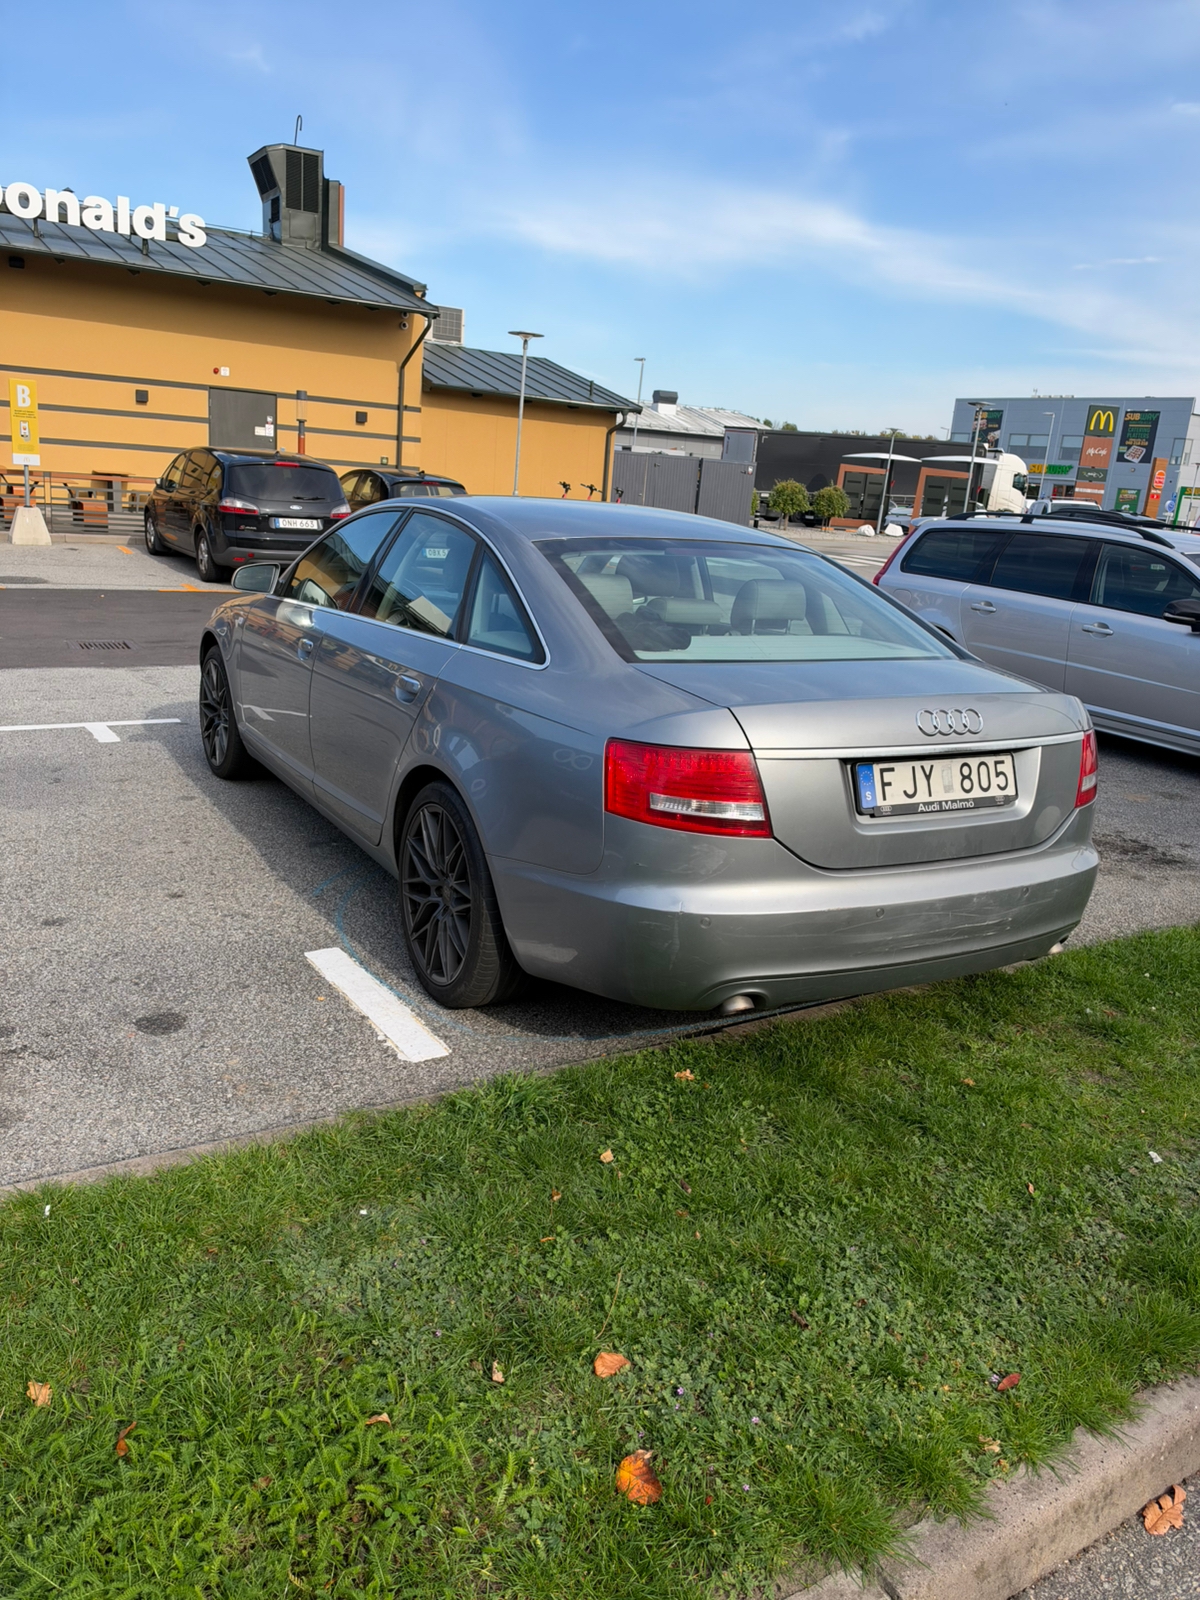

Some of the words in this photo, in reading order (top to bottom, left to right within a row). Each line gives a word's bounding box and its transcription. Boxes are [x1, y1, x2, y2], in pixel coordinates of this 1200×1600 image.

[0, 181, 207, 248] onald's
[16, 384, 31, 407] B
[281, 519, 298, 527] ONH
[299, 520, 315, 528] 663
[879, 764, 934, 801] FJY
[959, 760, 1009, 794] 805
[865, 791, 872, 800] S
[918, 801, 940, 812] Audi
[942, 799, 974, 811] Malmö
